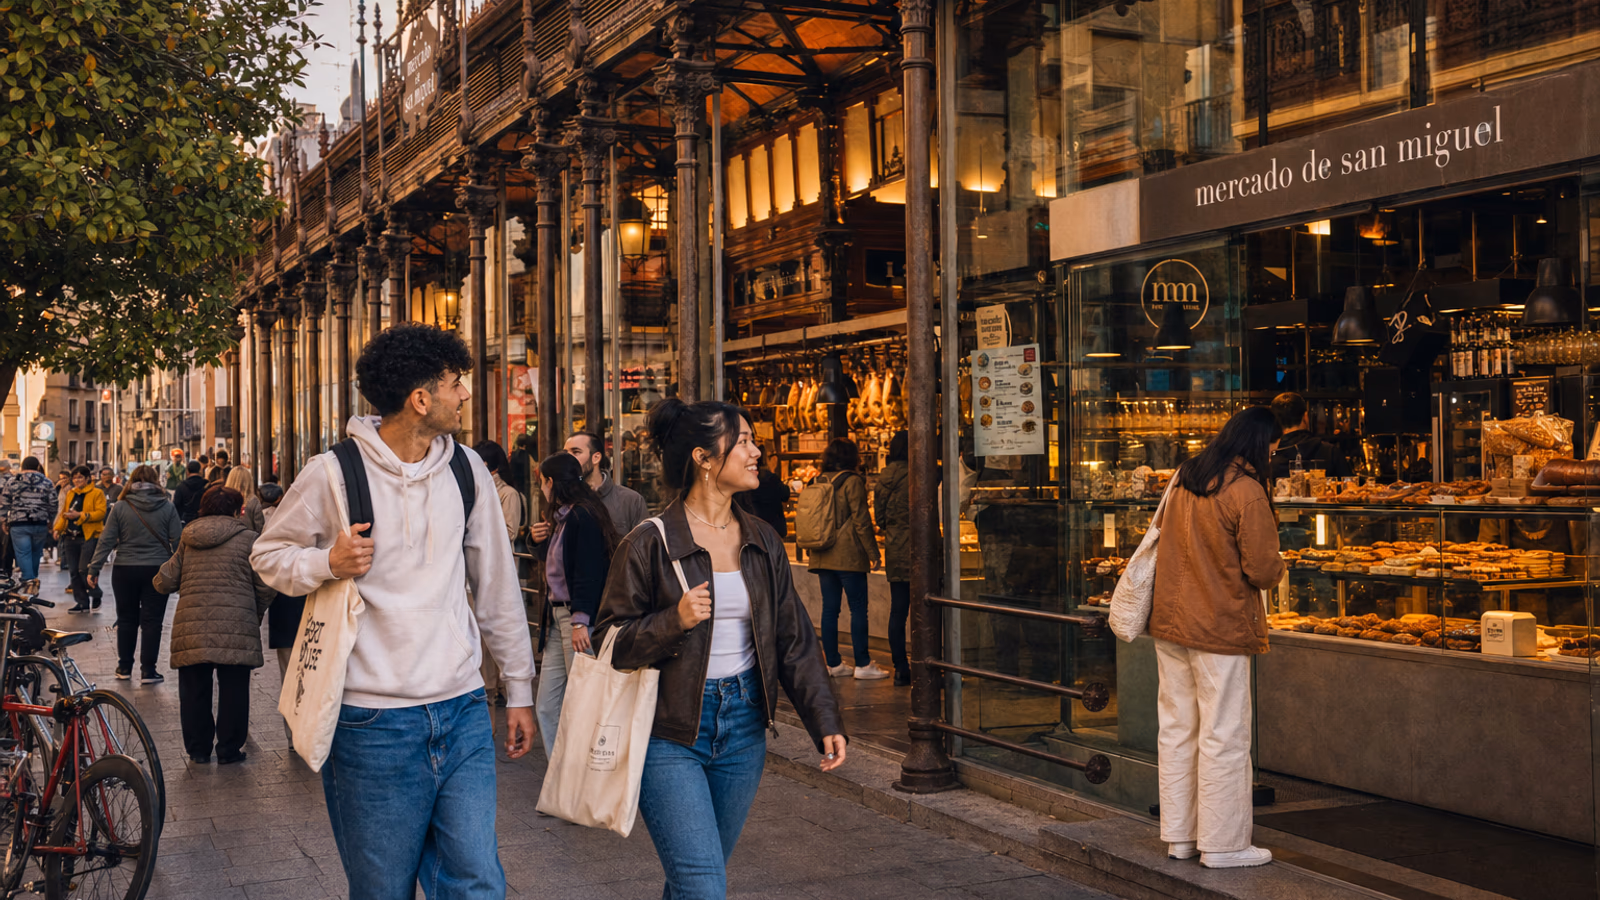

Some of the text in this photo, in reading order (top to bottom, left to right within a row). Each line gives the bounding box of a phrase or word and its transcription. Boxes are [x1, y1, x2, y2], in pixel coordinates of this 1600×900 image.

[1196, 105, 1504, 206] mercado de san miguel
